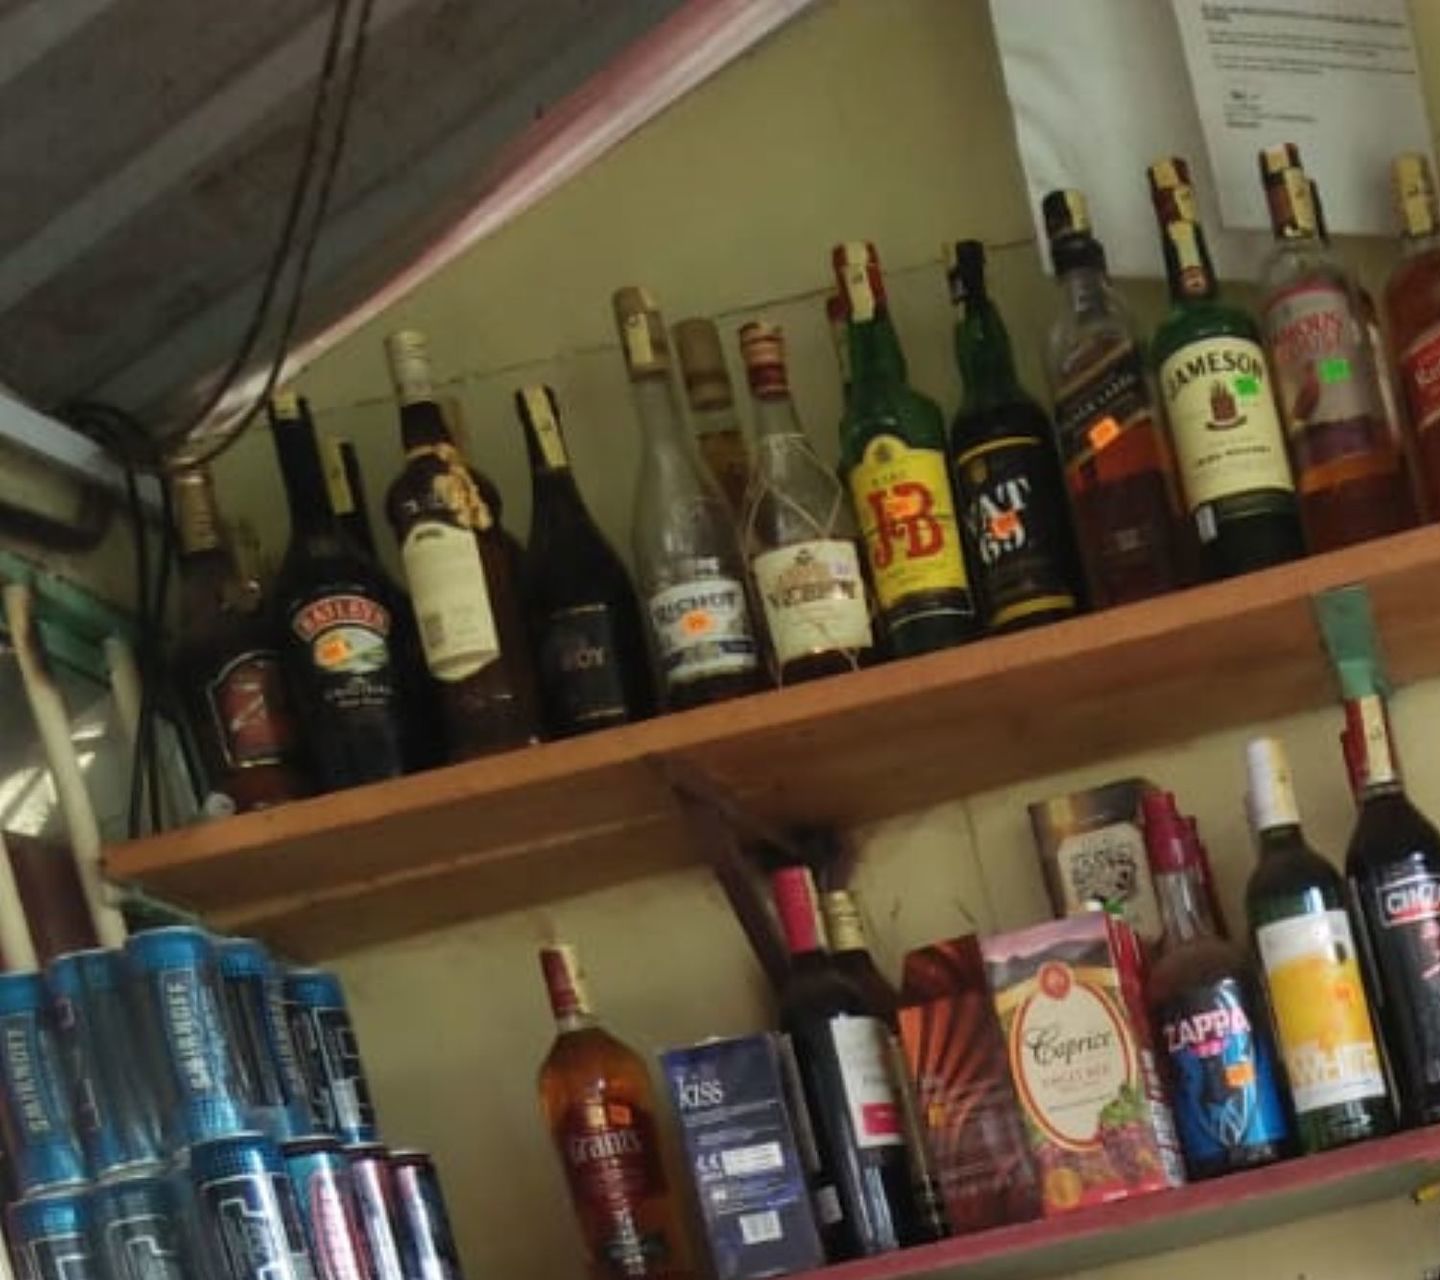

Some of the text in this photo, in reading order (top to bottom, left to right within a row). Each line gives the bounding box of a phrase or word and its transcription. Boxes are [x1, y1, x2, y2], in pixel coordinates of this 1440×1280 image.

[1166, 350, 1265, 401] JAMESON
[1164, 1005, 1251, 1053] ZAPPA
[675, 1071, 724, 1109] kiss
